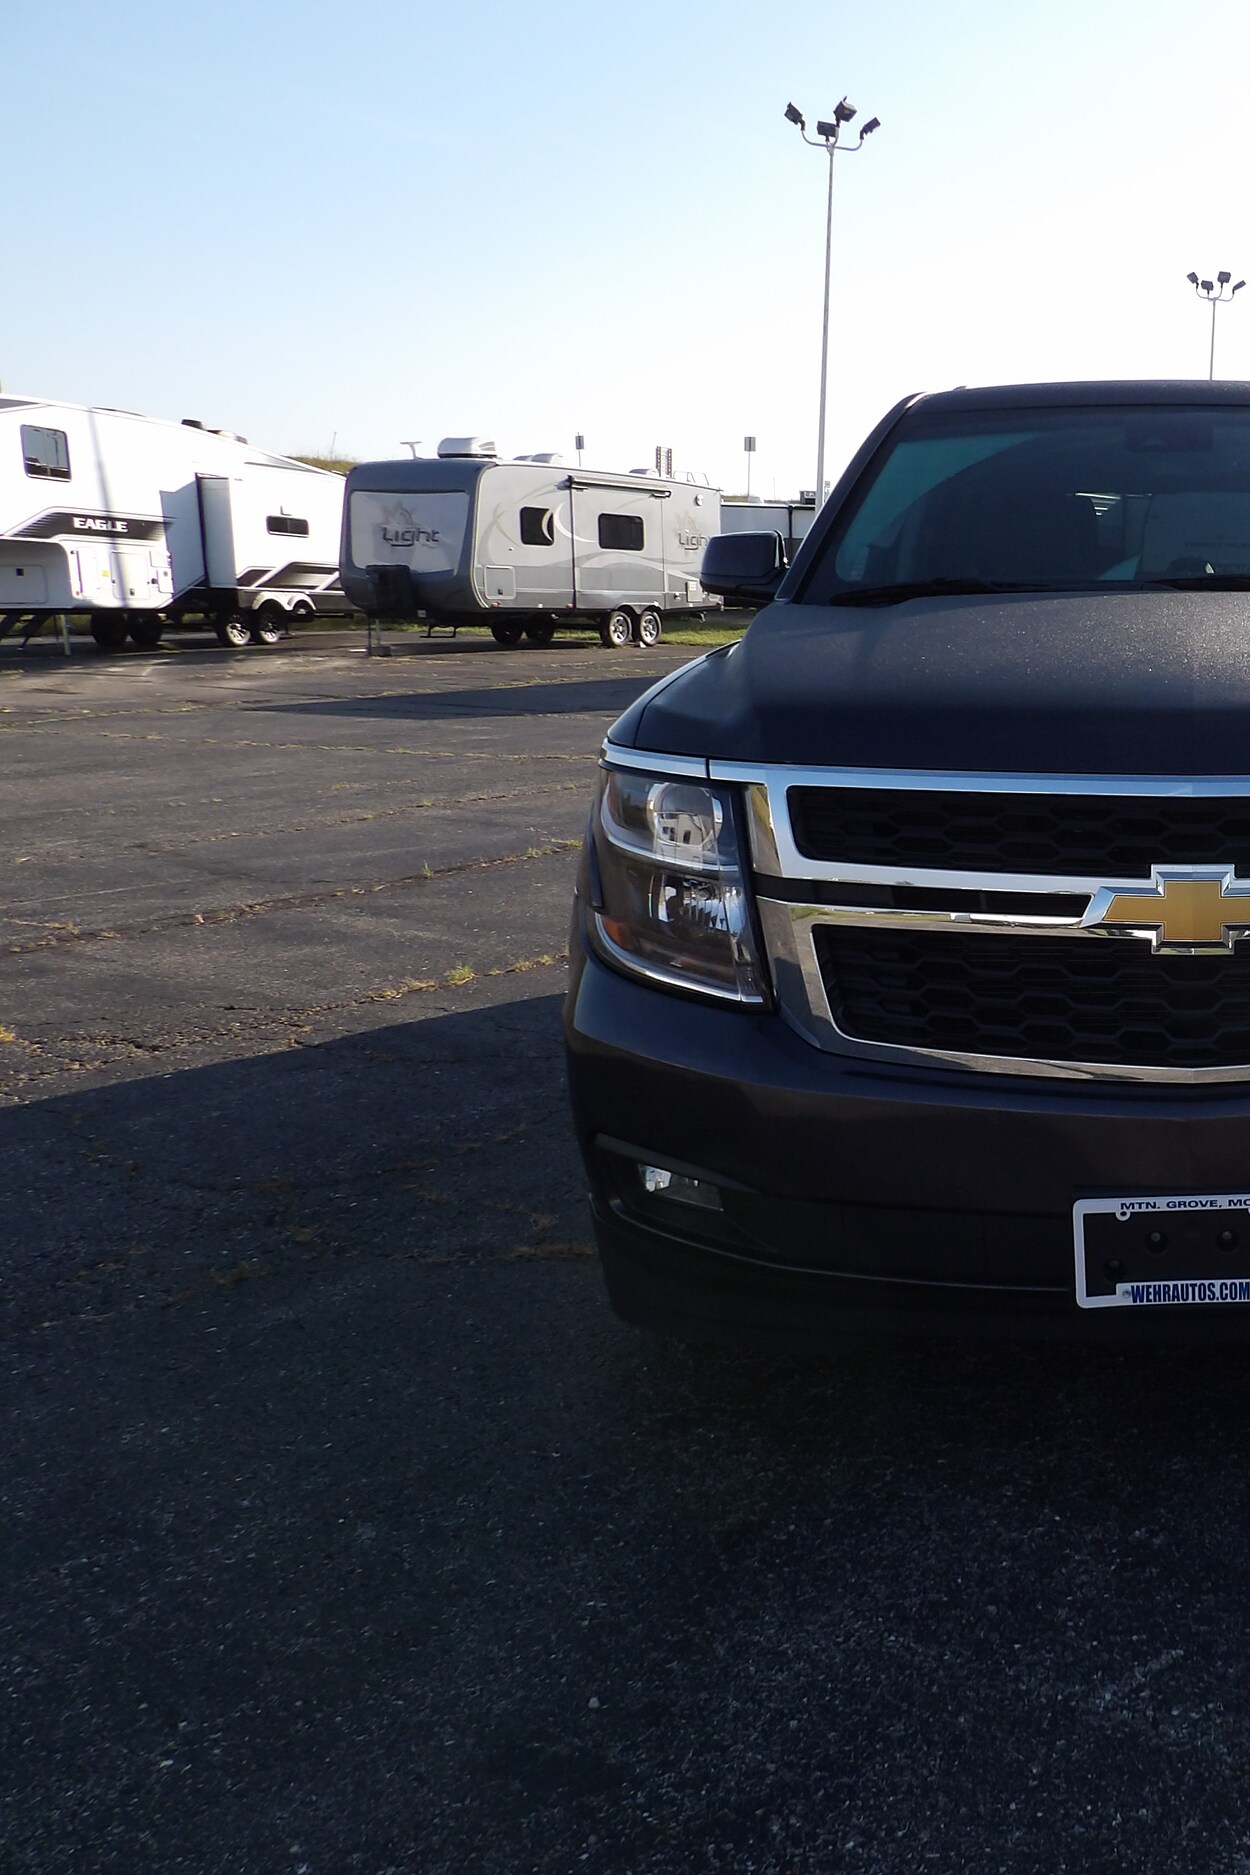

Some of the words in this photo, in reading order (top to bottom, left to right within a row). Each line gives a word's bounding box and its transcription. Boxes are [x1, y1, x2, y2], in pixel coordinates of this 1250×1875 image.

[73, 517, 128, 533] EAGLE
[382, 523, 440, 547] Light
[678, 530, 709, 550] Ligh
[1120, 1201, 1160, 1211] MTN.
[1166, 1199, 1222, 1209] GROVE,
[1131, 1281, 1250, 1303] WEHRAUTOS.COM
